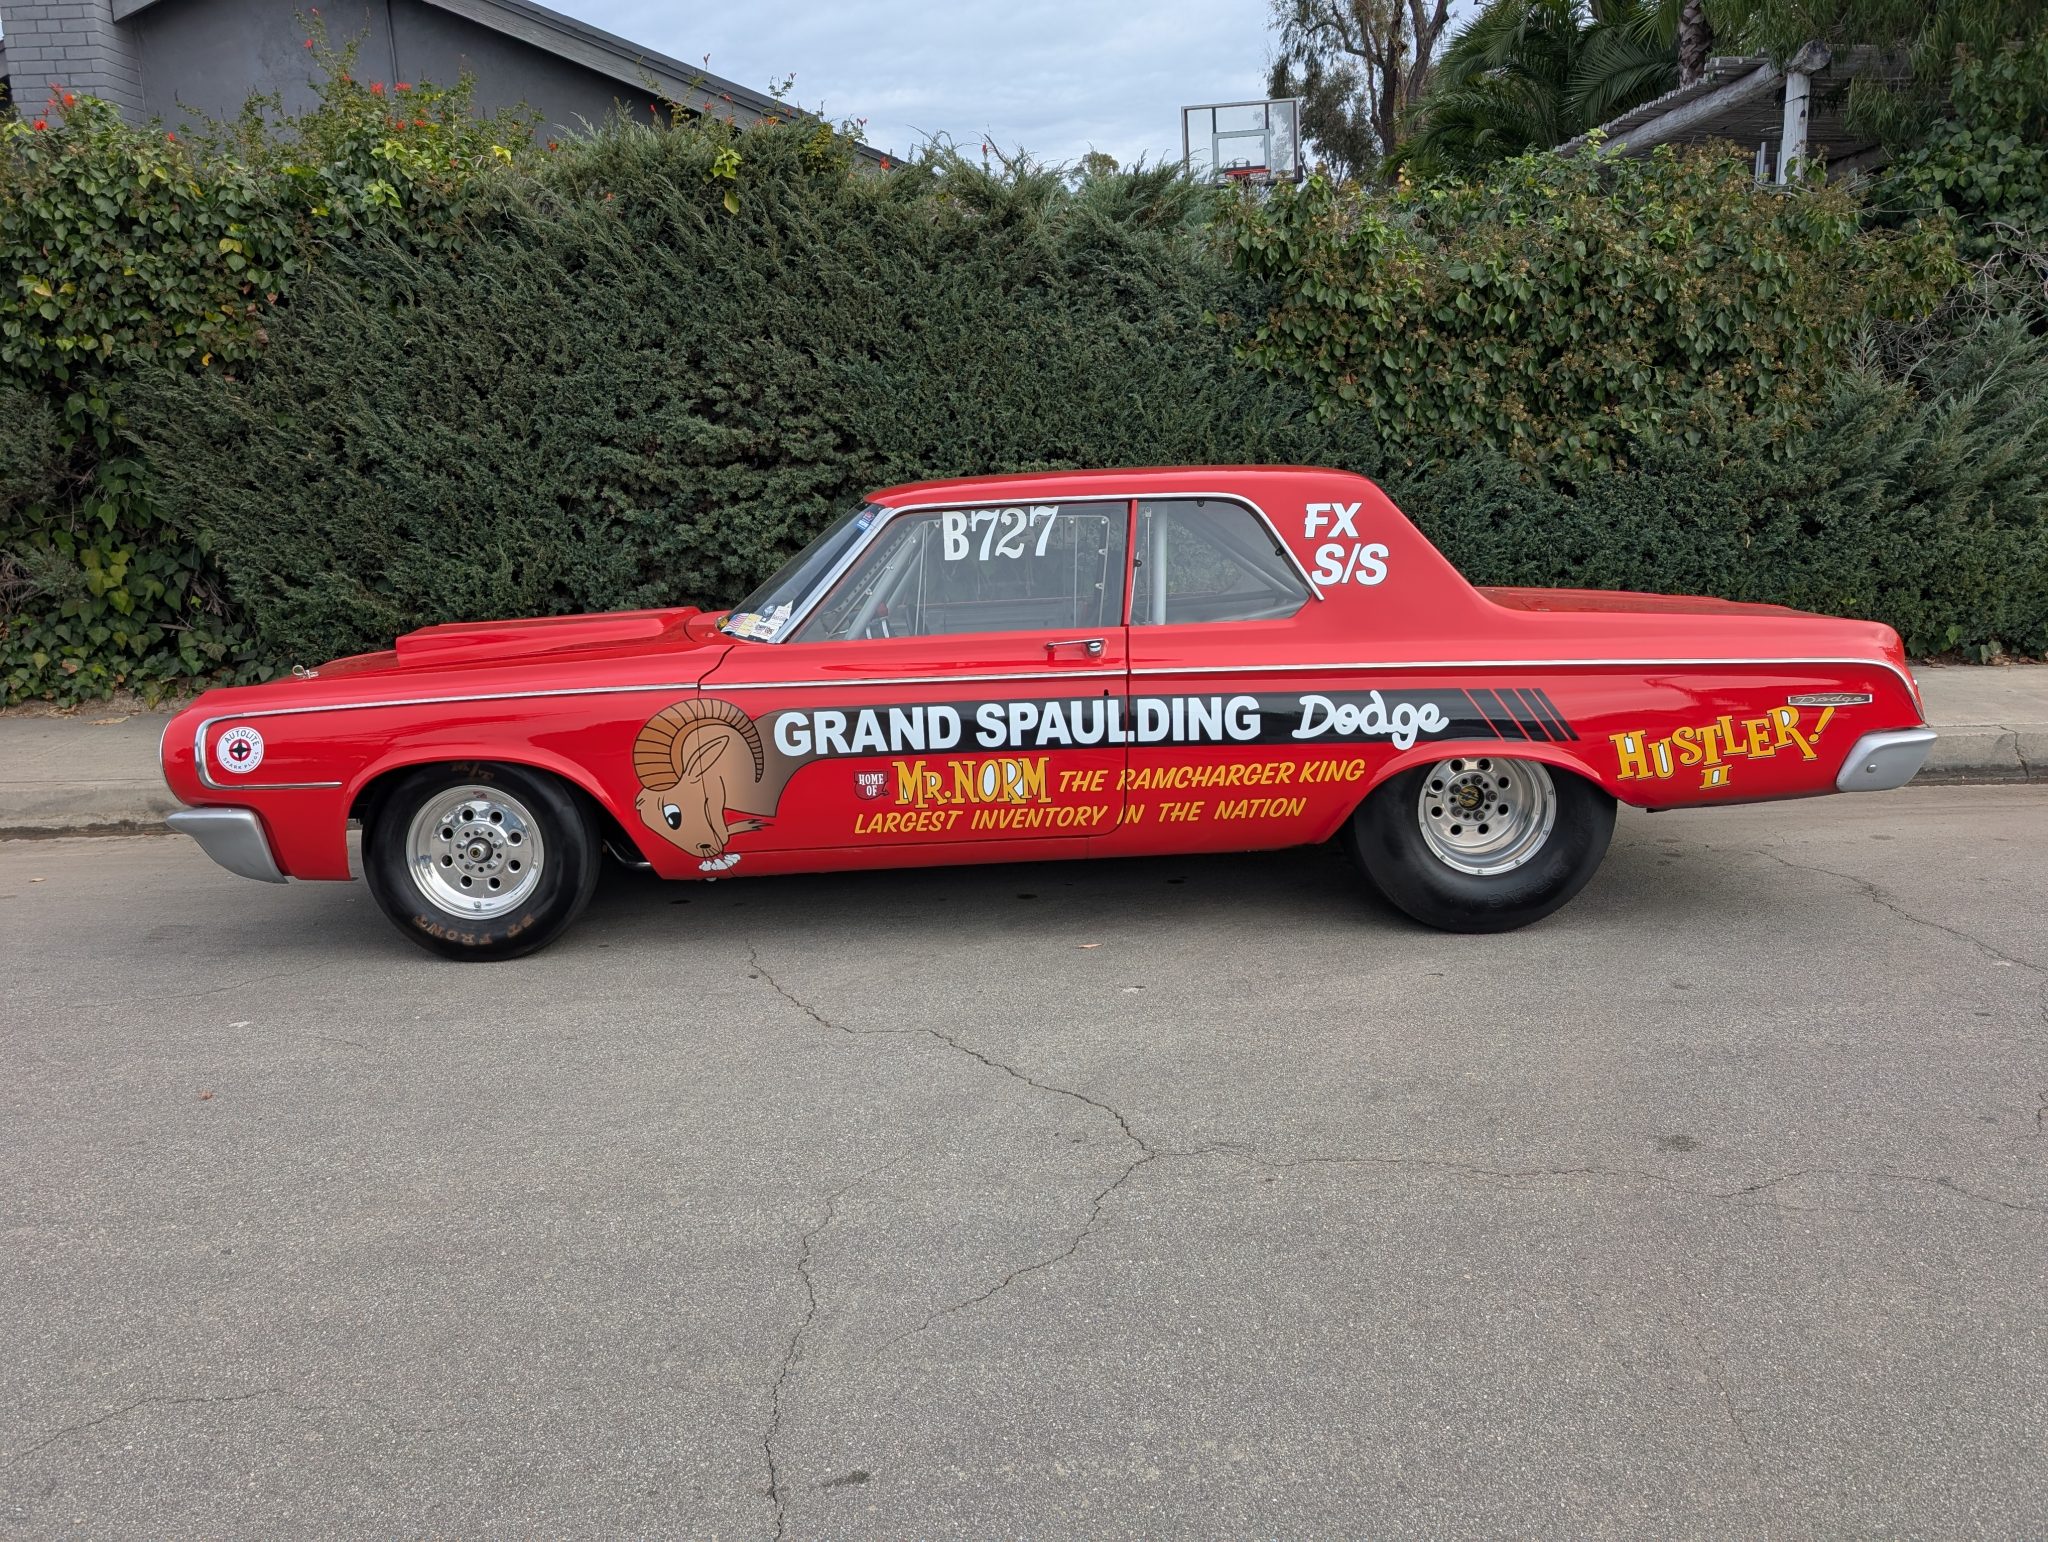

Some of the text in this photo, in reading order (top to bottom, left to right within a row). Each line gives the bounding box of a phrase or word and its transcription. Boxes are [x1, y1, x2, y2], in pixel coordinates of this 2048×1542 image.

[943, 506, 1059, 561] B727
[1304, 503, 1362, 538] FX
[1311, 543, 1389, 585] S/S
[1799, 694, 1864, 704] Dodge
[774, 690, 1449, 756] GRAND SPAULDING Dodge
[225, 730, 260, 746] AUTOLITE
[223, 751, 259, 769] SPARK PLUGS
[858, 773, 884, 785] HOME
[866, 785, 877, 796] OF
[1059, 759, 1365, 793] THE RAMCHARGER KING
[1699, 764, 1733, 789] II
[854, 797, 1307, 834] LARGEST INVENTORY IN THE NATION
